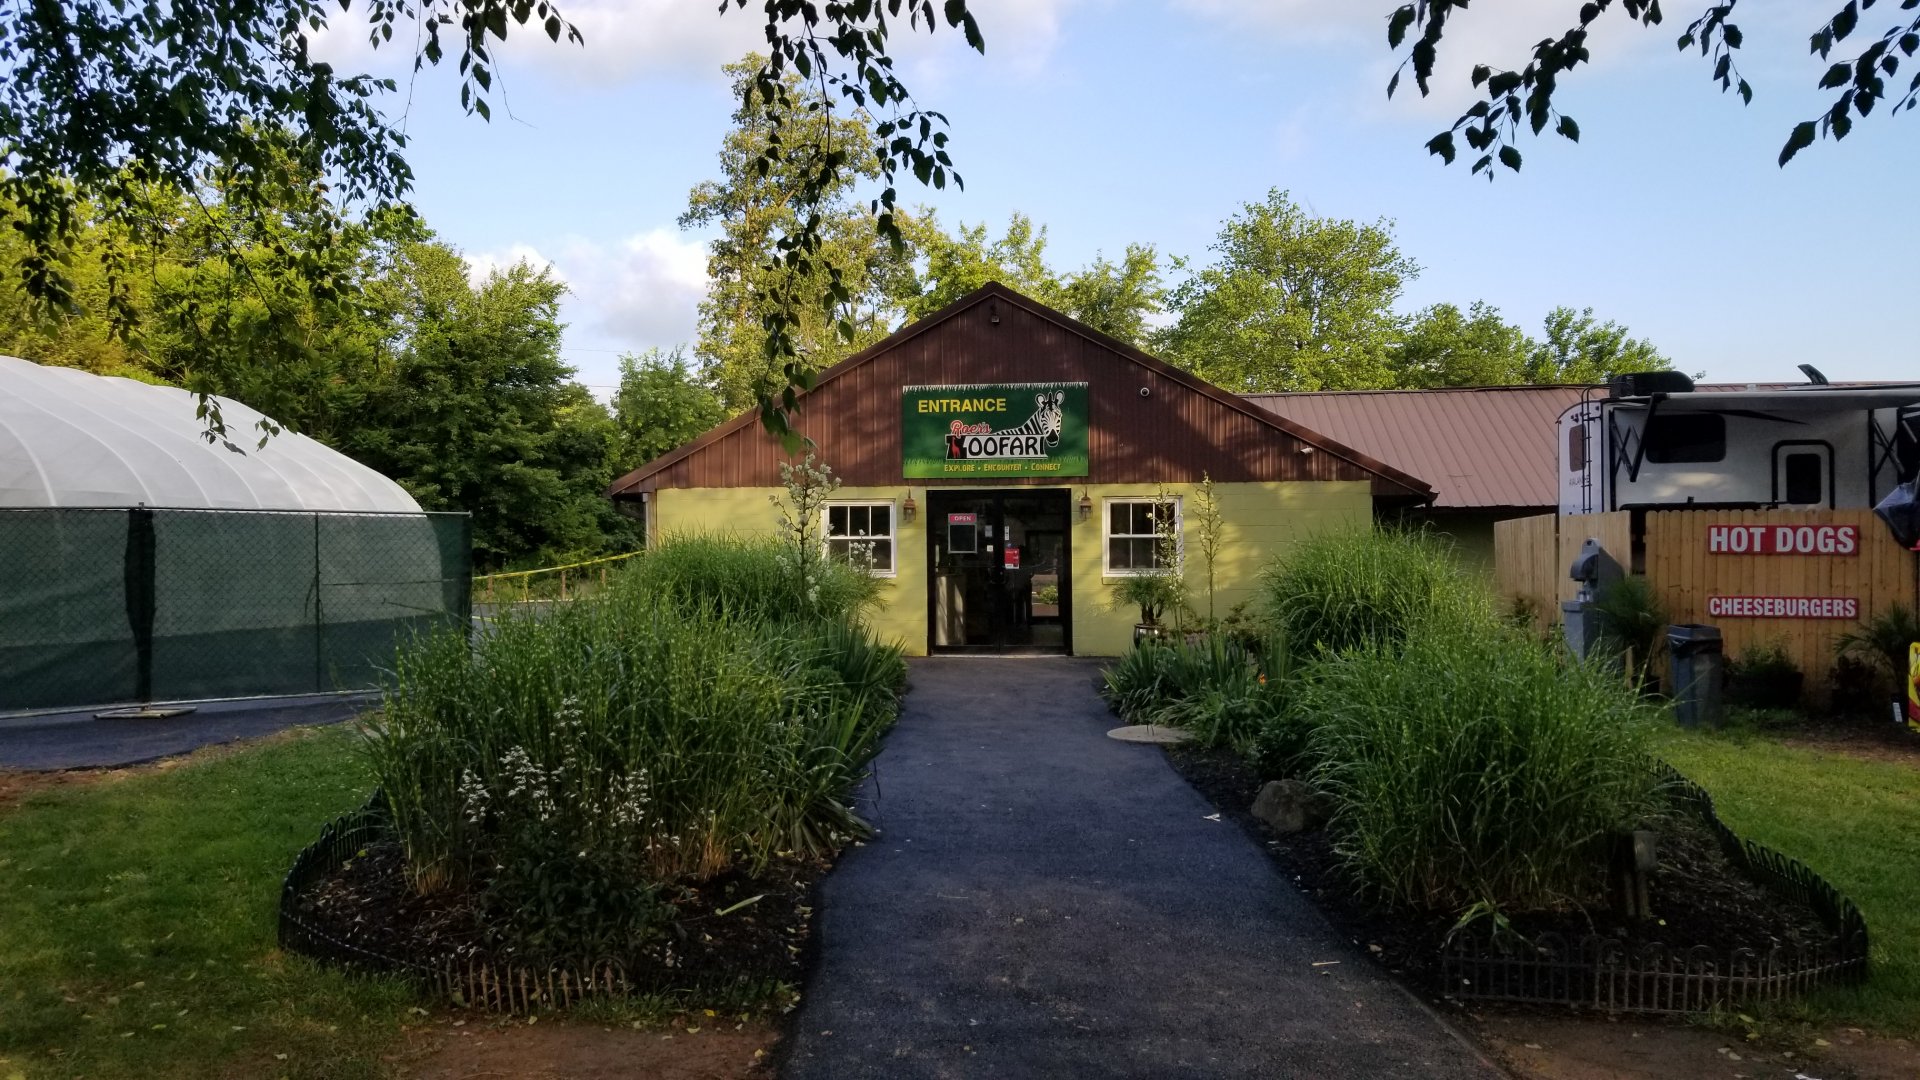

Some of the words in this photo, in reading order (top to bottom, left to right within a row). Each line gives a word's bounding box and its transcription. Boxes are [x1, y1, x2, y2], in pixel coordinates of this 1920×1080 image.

[919, 399, 1006, 413] ENTRANCE
[944, 464, 975, 472] EXPLORE
[983, 463, 1022, 472] ENCOUNTER
[1030, 462, 1061, 471] CONNECT
[1710, 527, 1766, 552] HOT
[1776, 527, 1855, 553] DOGS
[1709, 598, 1856, 617] CHEESEBURGERS
